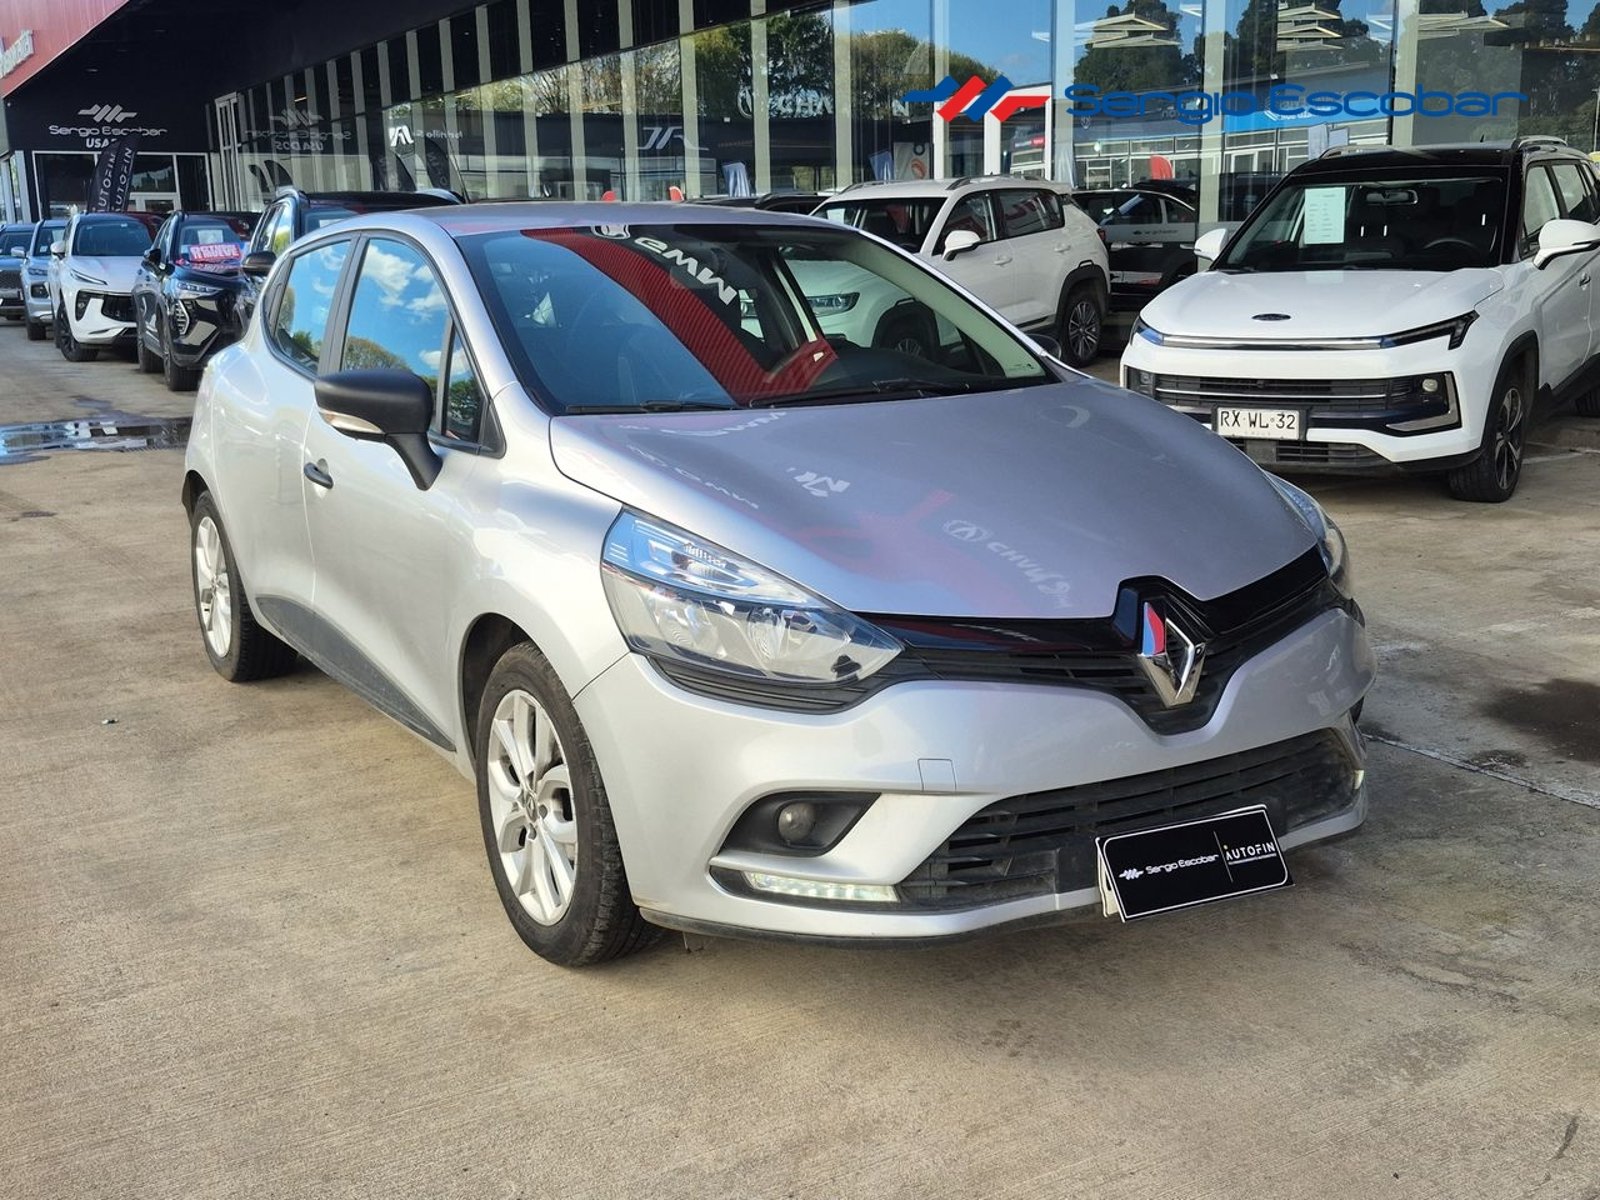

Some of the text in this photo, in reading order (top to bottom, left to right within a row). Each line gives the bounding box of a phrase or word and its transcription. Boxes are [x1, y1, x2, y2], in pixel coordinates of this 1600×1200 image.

[98, 153, 117, 211] UTOFIN
[115, 147, 133, 211] UTOFIN
[1178, 854, 1220, 868] Escobar
[1223, 842, 1276, 861] AUTOFIN
